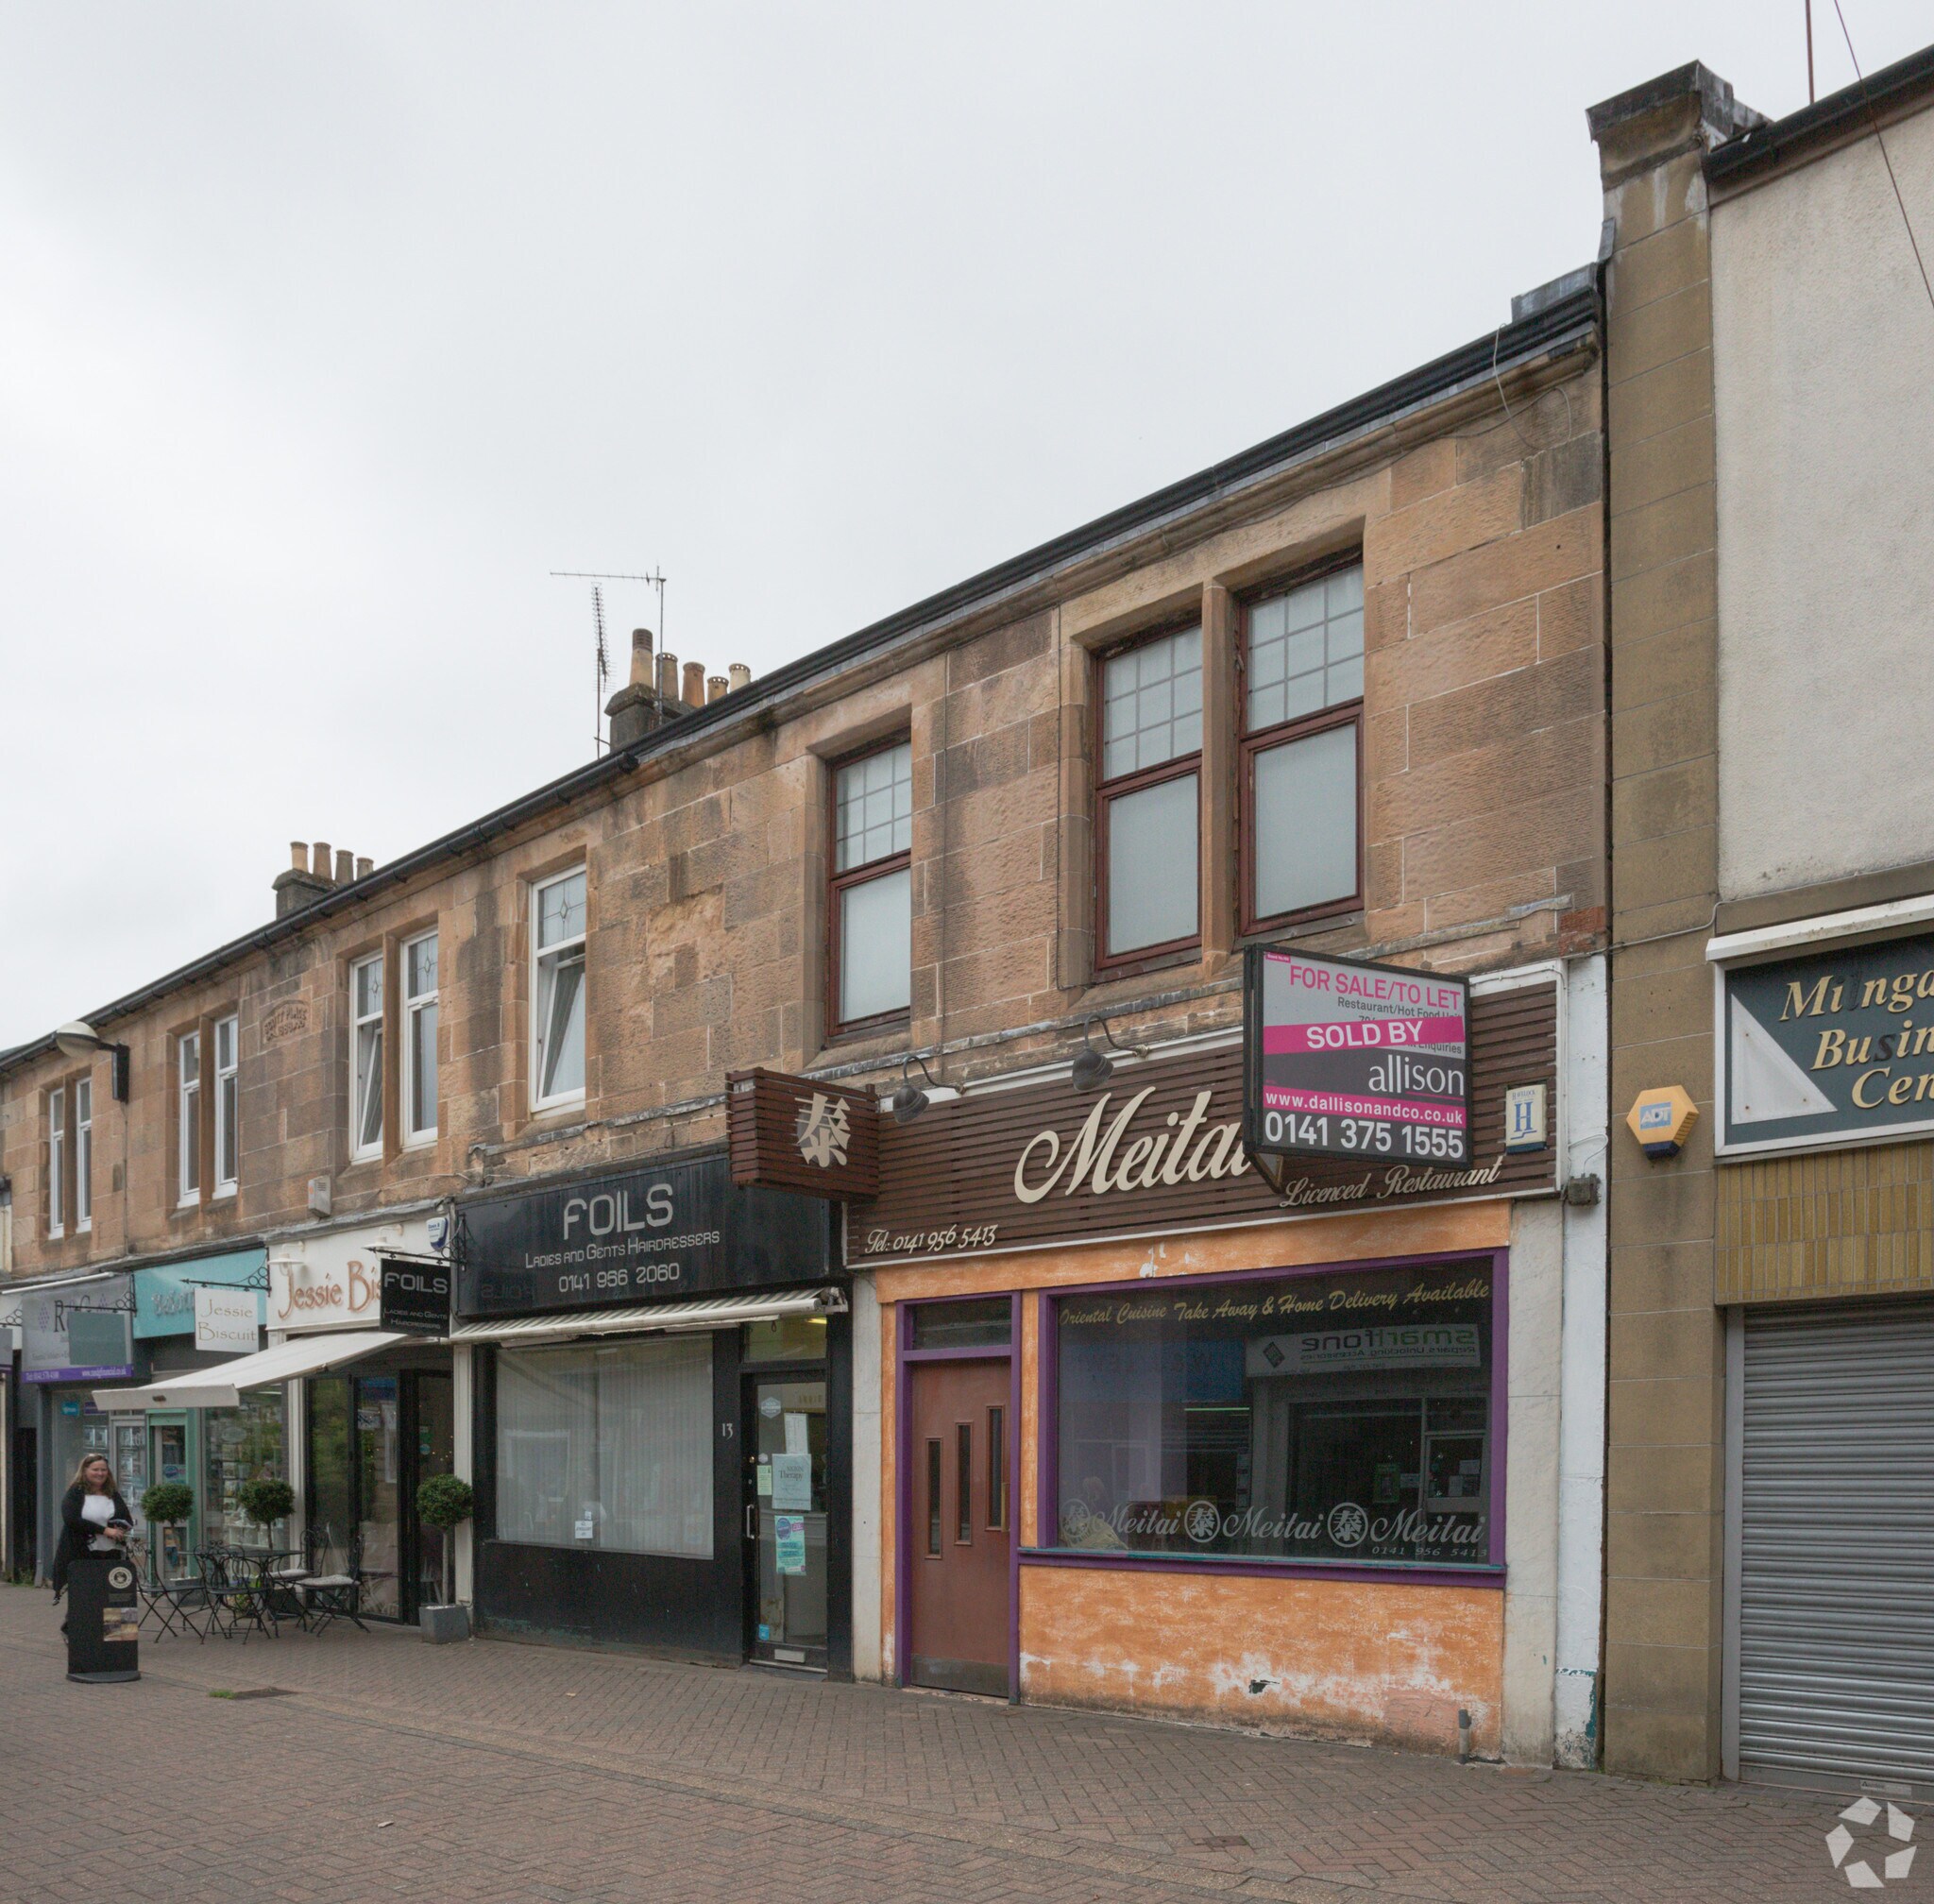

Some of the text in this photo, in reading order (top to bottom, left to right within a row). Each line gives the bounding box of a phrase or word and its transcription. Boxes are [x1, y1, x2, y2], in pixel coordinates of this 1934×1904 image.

[1290, 965, 1461, 1011] FOR SALE/TO LET
[1337, 996, 1416, 1017] Restaurant/Hot
[1306, 1020, 1423, 1048] SOLD BY
[1368, 1054, 1464, 1096] allison
[1265, 1092, 1463, 1125] www.dallisonandco.co.uk
[1640, 1106, 1671, 1125] ADT
[1264, 1112, 1463, 1159] 0141 375 1555
[1280, 1155, 1503, 1207] Licenced Restaurant
[564, 1182, 673, 1240] FOILS
[865, 1224, 998, 1254] Tel: 0141 956 5413
[279, 1265, 343, 1319] Jessie
[384, 1272, 449, 1295] FOILS
[558, 1263, 680, 1293] 0141 956 2060
[200, 1299, 253, 1318] Jessie
[1059, 1278, 1489, 1326] Oriental Cuisine Take Away & Home Delivery Available
[198, 1321, 257, 1341] Biscuit
[722, 1422, 733, 1440] 13
[1222, 1505, 1324, 1540] Meitai
[1370, 1508, 1486, 1544] Meitai
[1372, 1546, 1487, 1557] 0141 956 5413
